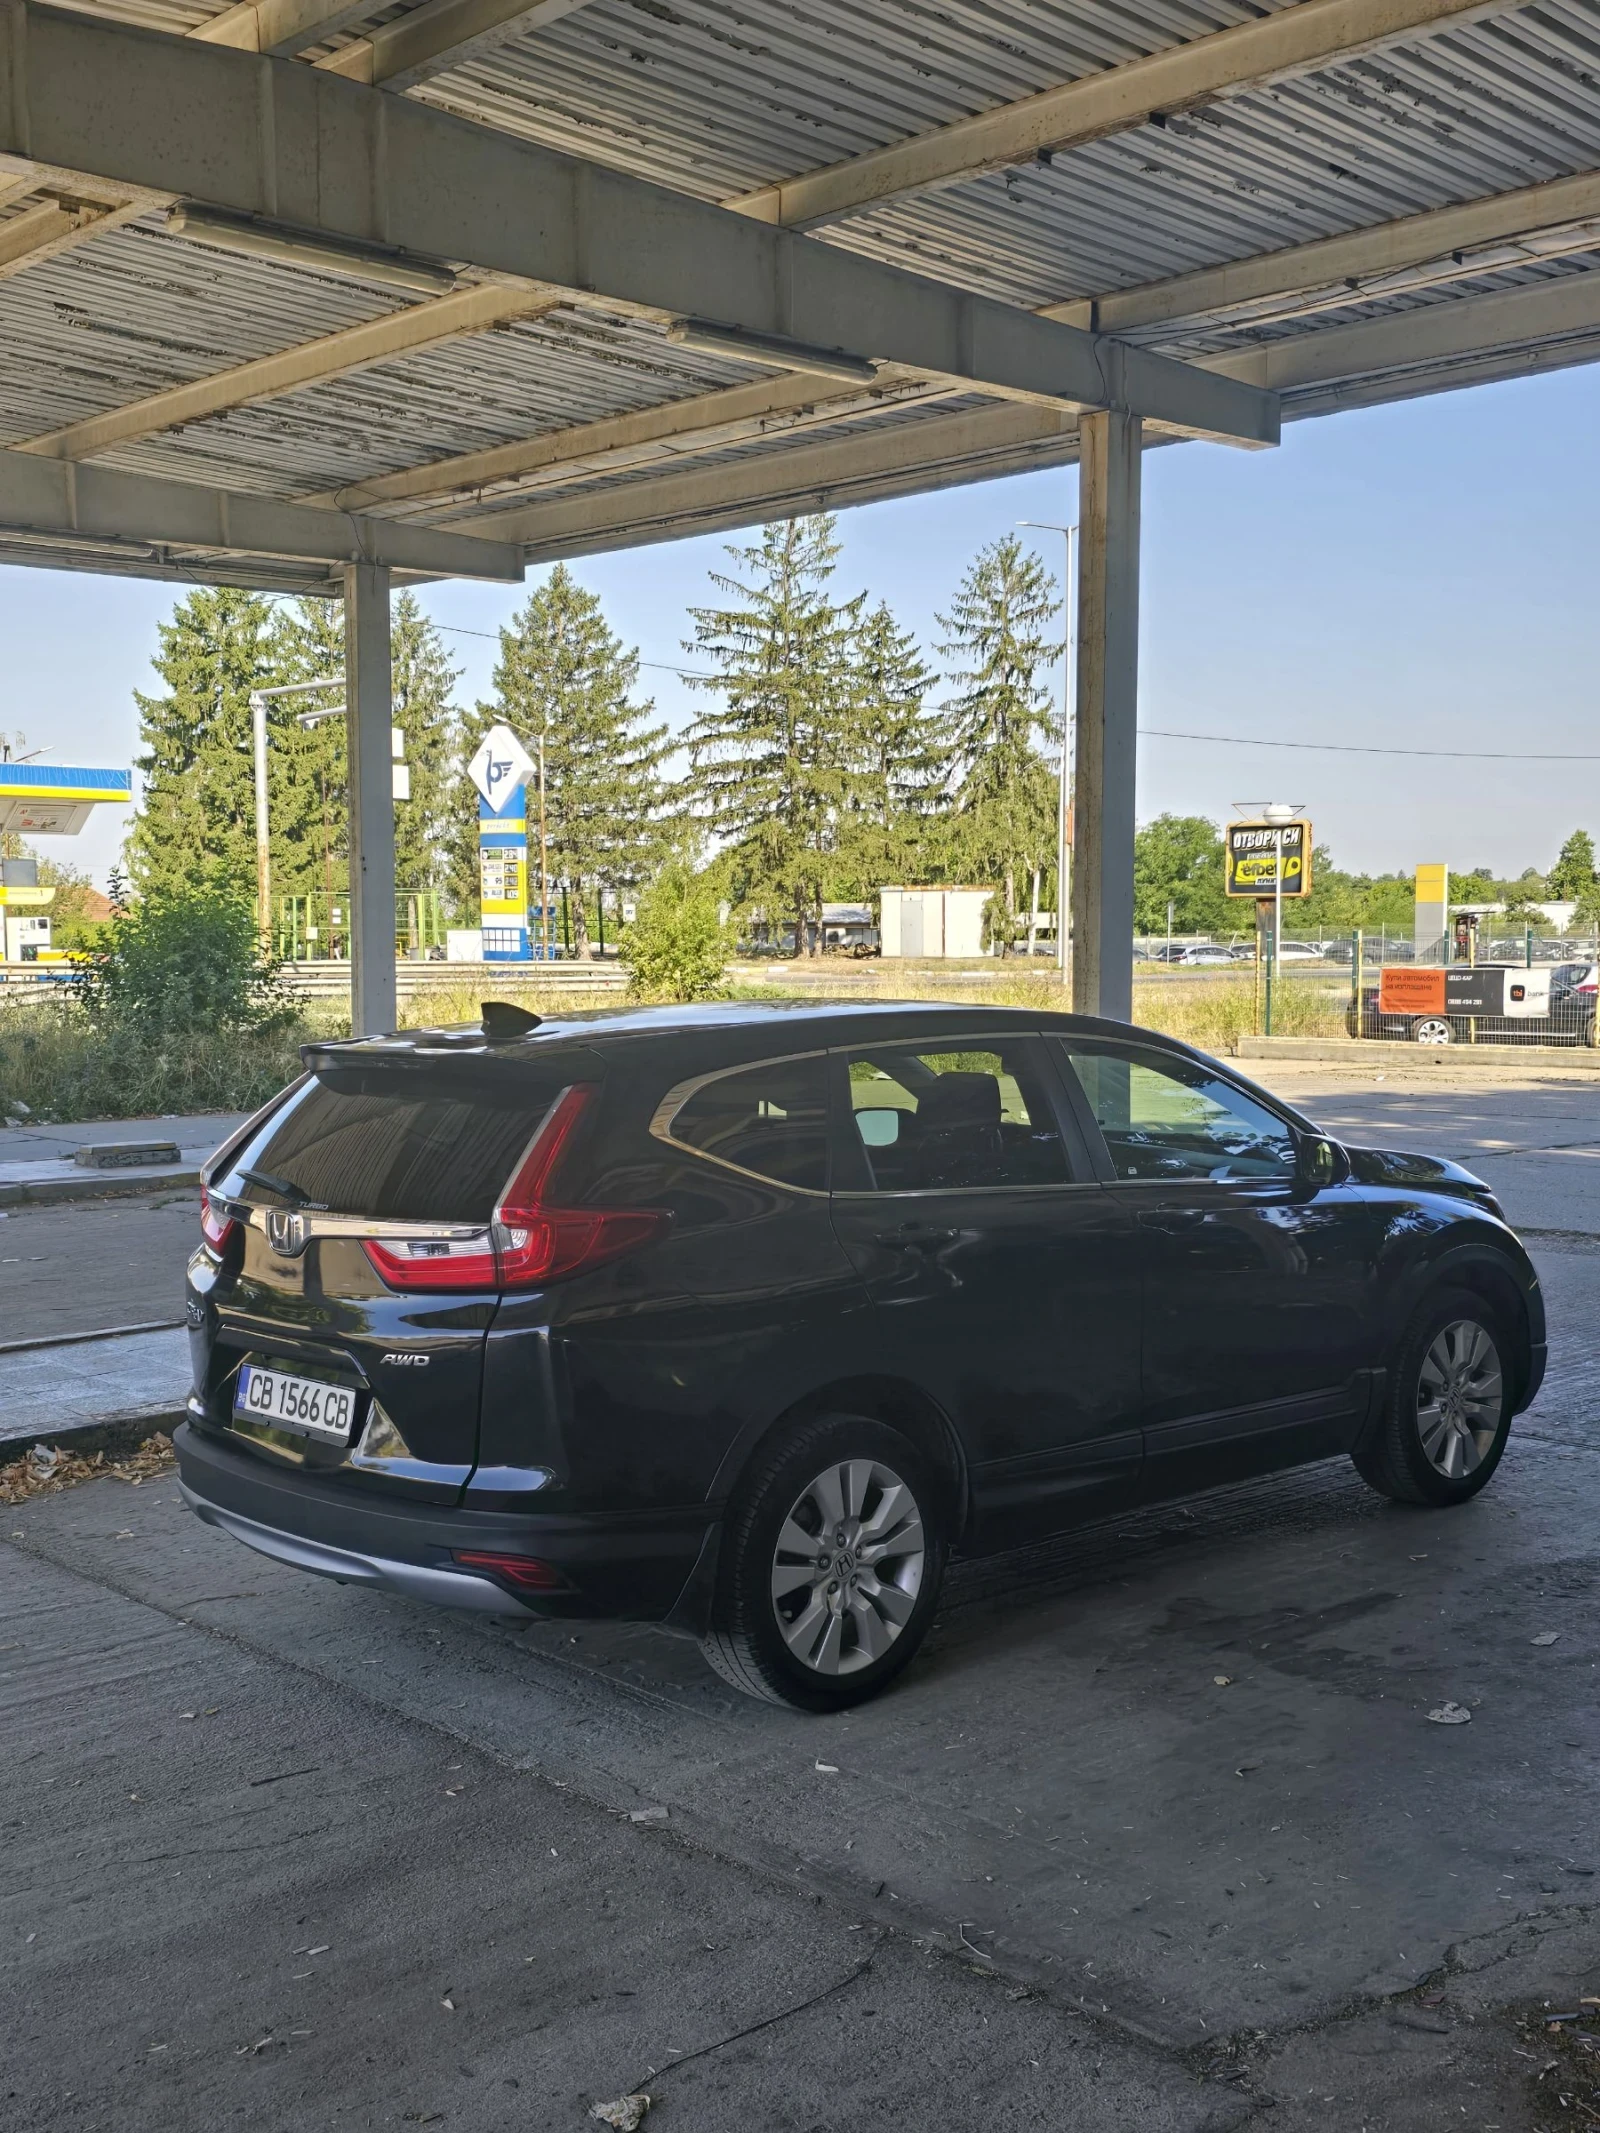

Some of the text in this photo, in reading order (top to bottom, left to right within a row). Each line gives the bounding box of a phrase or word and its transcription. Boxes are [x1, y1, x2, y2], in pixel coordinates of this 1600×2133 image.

[1233, 827, 1300, 849] ОТВОРИ СИ
[1403, 974, 1440, 982] автомобил
[1513, 989, 1523, 997] tbi
[299, 1201, 328, 1210] TURBO
[380, 1354, 430, 1366] AWD
[249, 1374, 273, 1410] CB
[279, 1380, 320, 1422] 1566
[323, 1391, 349, 1429] CB
